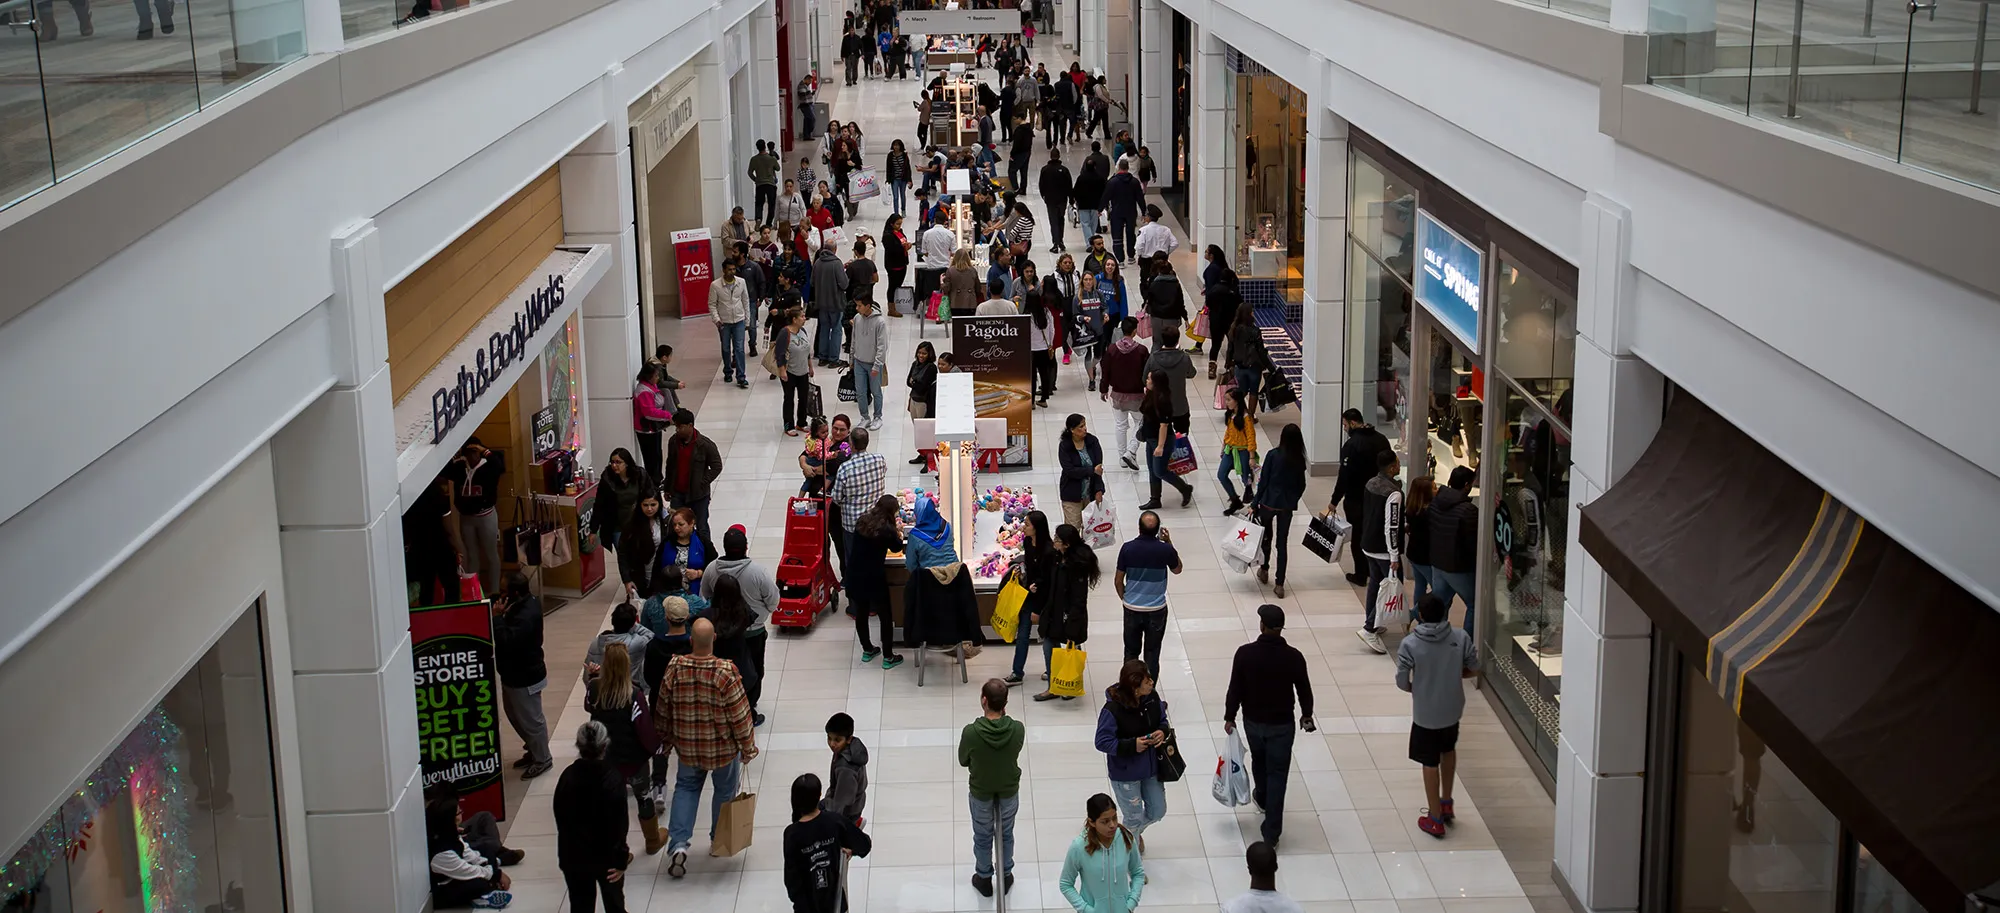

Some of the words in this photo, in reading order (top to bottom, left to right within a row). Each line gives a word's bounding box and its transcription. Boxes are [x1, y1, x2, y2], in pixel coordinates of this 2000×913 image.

[653, 118, 668, 150] THE
[669, 96, 692, 138] LIMITED
[677, 232, 689, 240] $12
[1424, 247, 1437, 265] CALL
[682, 262, 709, 277] 70%
[1443, 263, 1479, 312] SPRING
[964, 323, 1019, 340] Pagoda
[430, 365, 477, 445] Bath
[476, 348, 491, 398] &
[489, 312, 527, 382] Body
[525, 274, 565, 338] Works
[537, 414, 554, 429] TOTE!
[537, 429, 555, 451] $30
[1306, 526, 1335, 552] EXPRESS
[1496, 513, 1511, 553] 30
[818, 582, 825, 604] 5
[418, 650, 478, 668] ENTIRE
[414, 663, 484, 685] STORE!
[415, 682, 469, 711] BUY
[475, 680, 491, 702] 3
[418, 707, 469, 736] GET
[477, 705, 493, 728] 3
[422, 752, 500, 786] verything!
